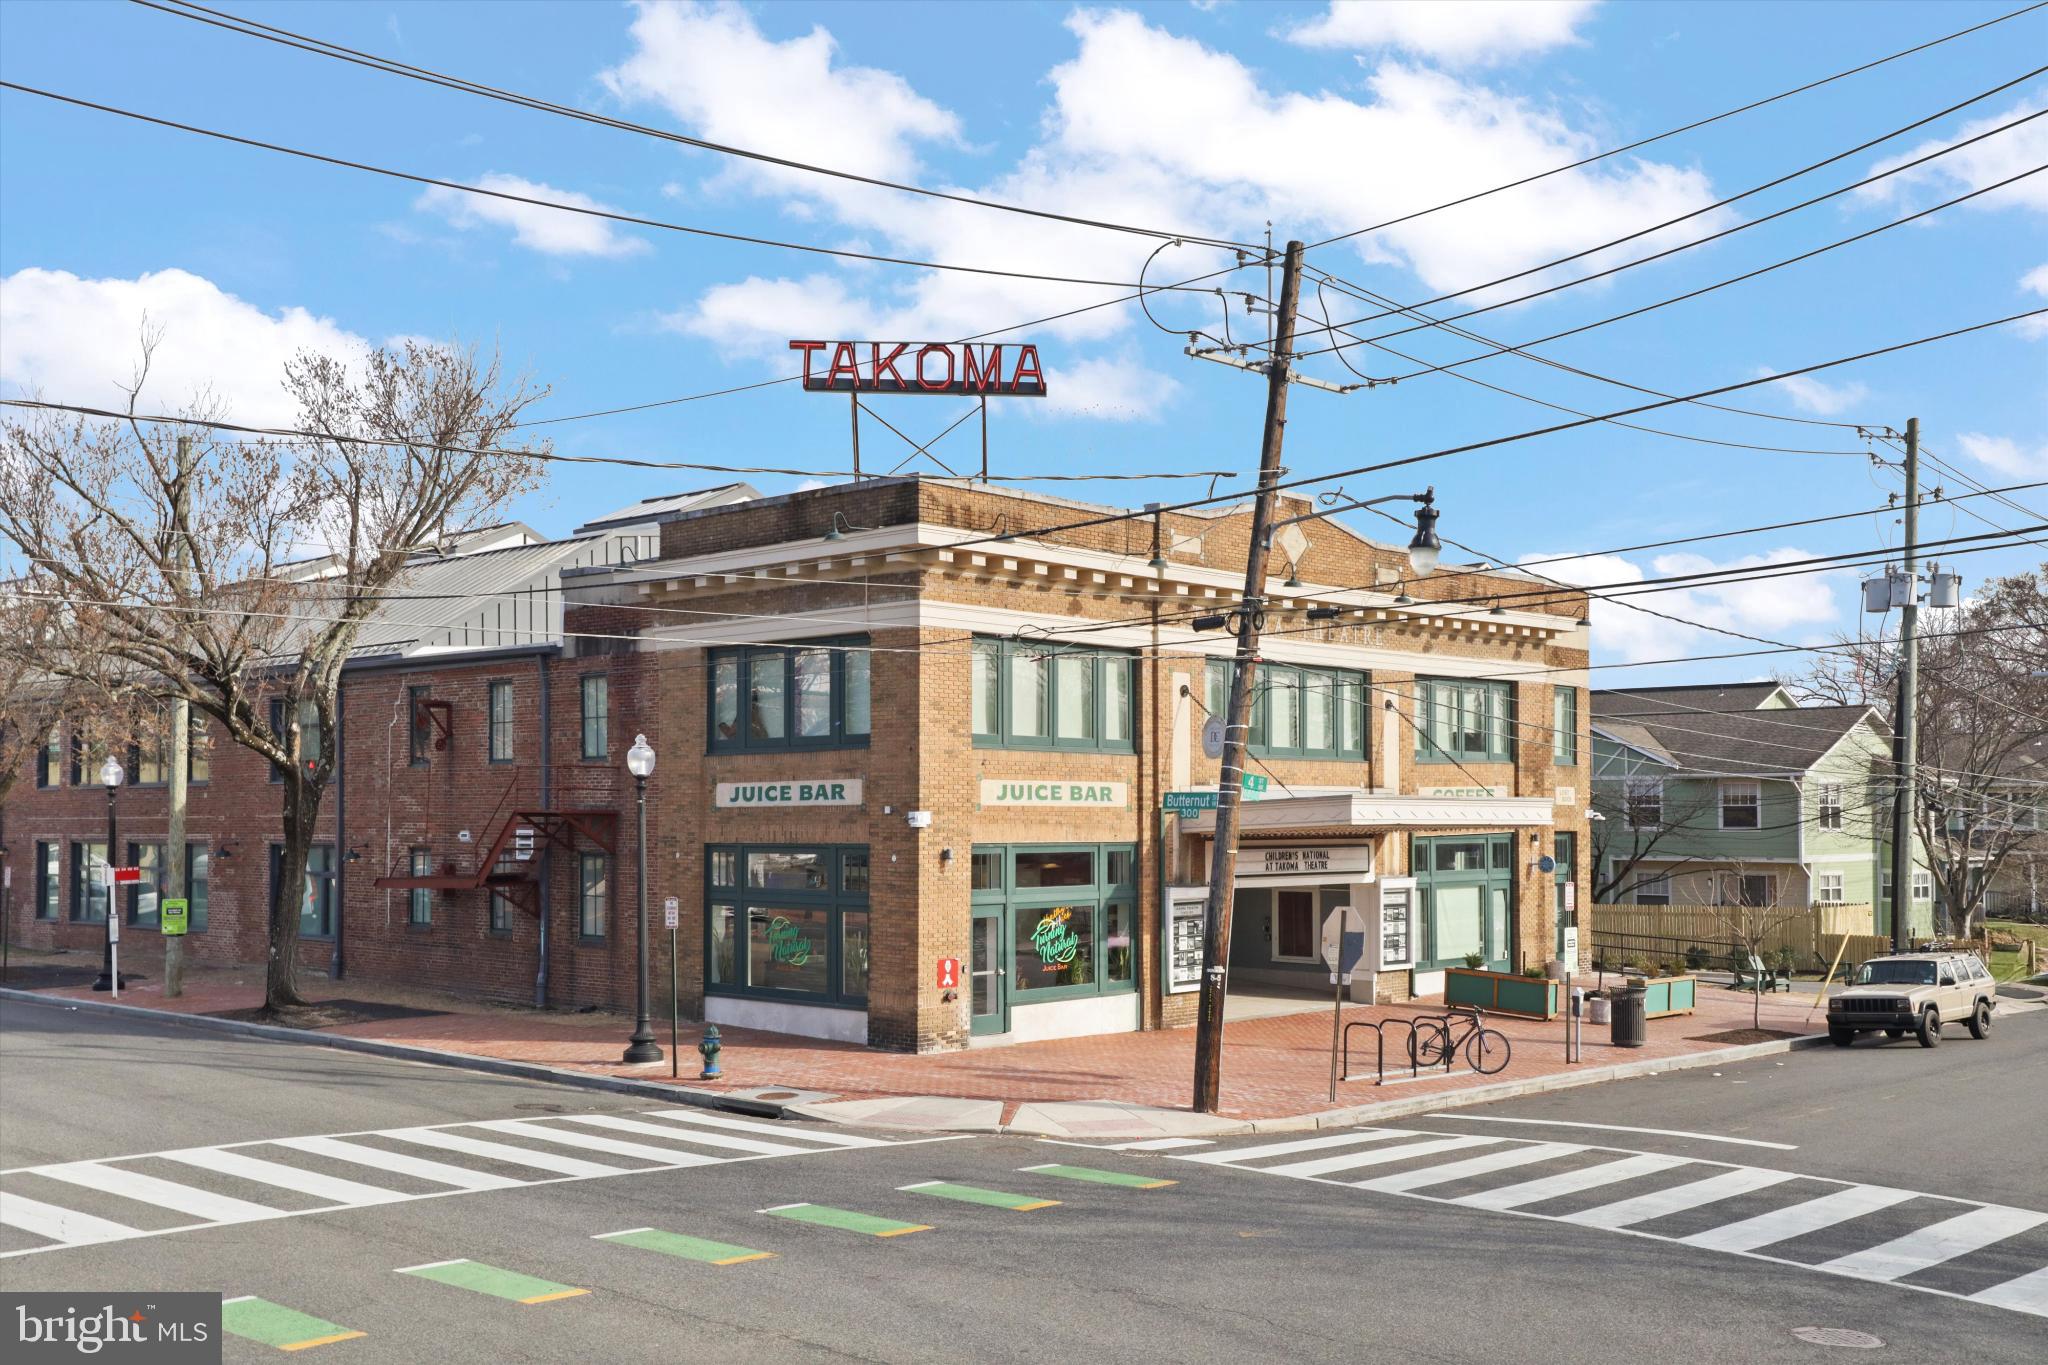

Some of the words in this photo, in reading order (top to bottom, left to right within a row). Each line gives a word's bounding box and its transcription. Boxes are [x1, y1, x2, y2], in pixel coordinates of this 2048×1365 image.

[790, 340, 1046, 391] TAKOMA
[1301, 617, 1384, 647] THEATRE
[1247, 775, 1255, 788] 4
[729, 785, 792, 803] JUICE
[799, 783, 846, 801] BAR
[996, 784, 1063, 801] JUICE
[1069, 785, 1113, 802] BAR
[1166, 794, 1210, 807] Butternut
[1180, 808, 1198, 818] 300
[1264, 850, 1299, 861] CHILDREN'S
[1302, 850, 1330, 860] NATIONAL
[1265, 863, 1273, 871] AT
[1275, 861, 1299, 871] TAKOMA
[1304, 860, 1328, 870] THEATRE
[1030, 922, 1066, 951] Turning
[1039, 932, 1078, 963] Natural
